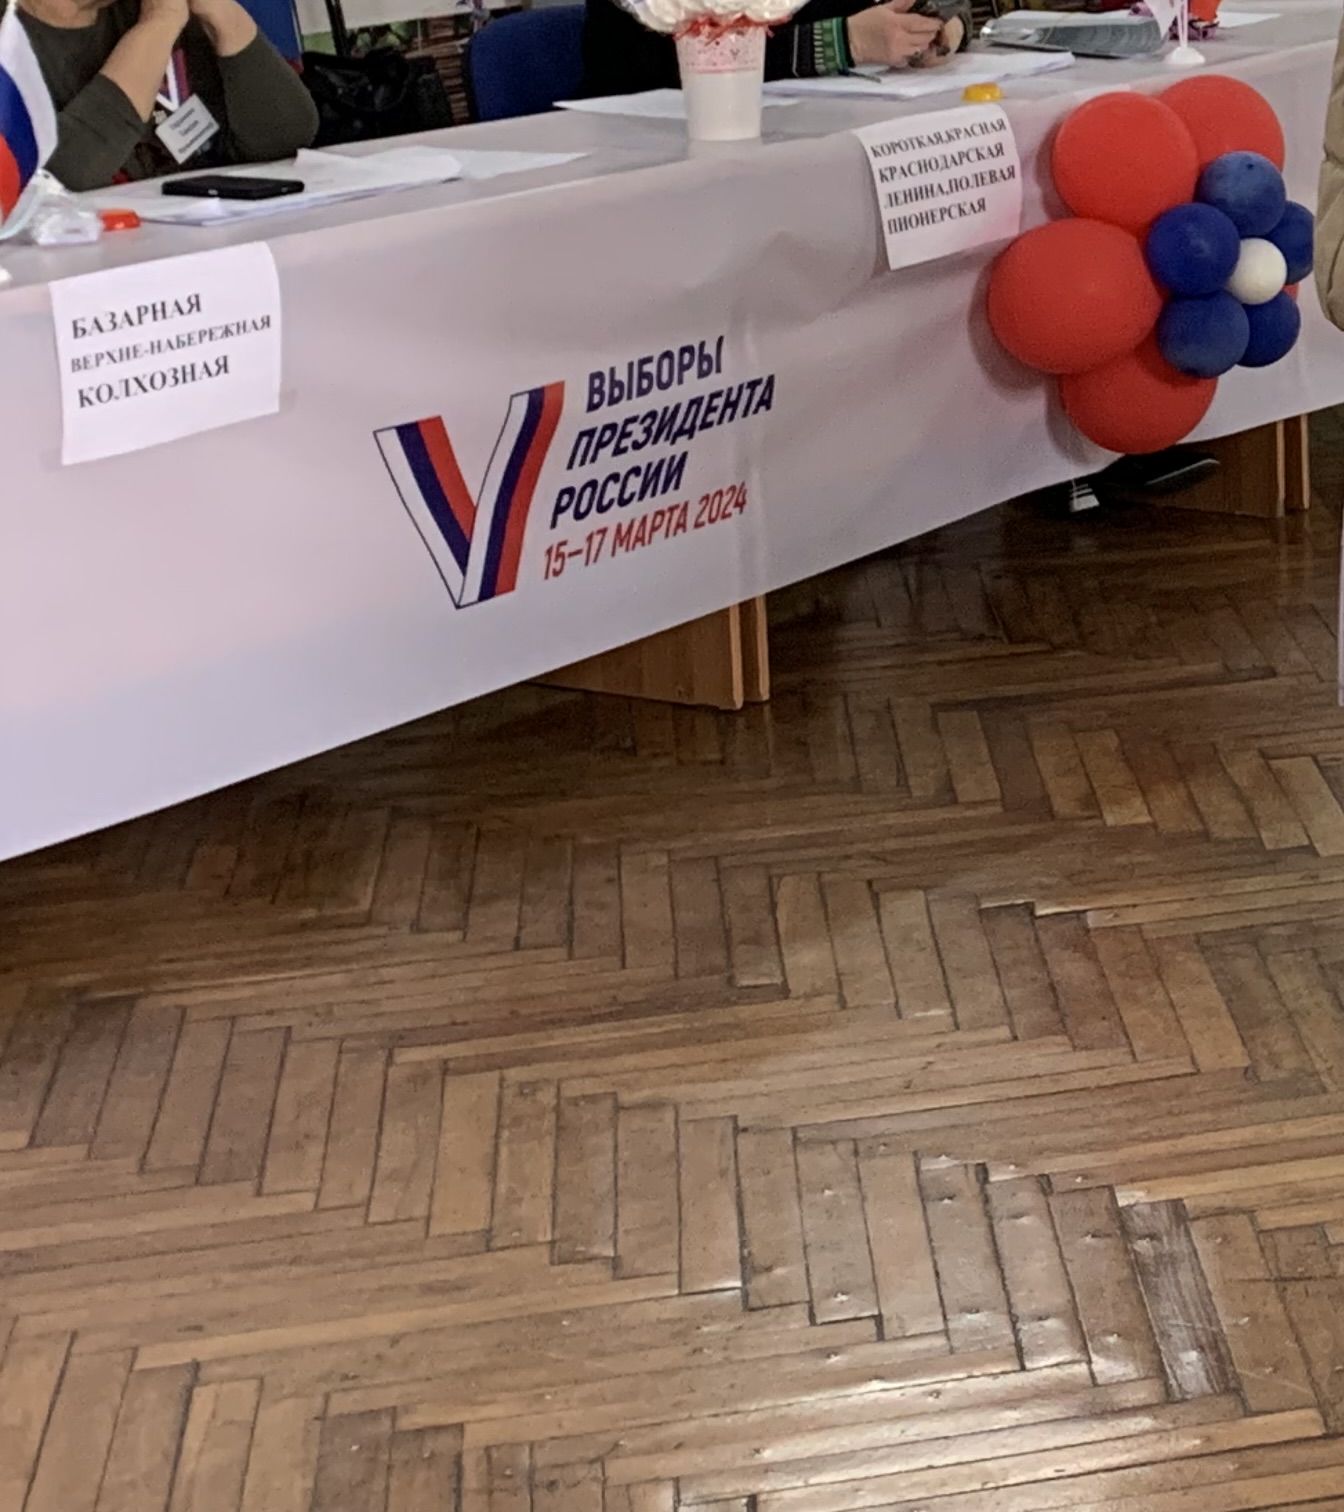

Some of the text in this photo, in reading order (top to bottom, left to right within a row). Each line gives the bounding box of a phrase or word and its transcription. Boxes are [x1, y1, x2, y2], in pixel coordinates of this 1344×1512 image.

[878, 141, 1005, 184] КРАСНОДАРСКАЯ
[887, 197, 987, 235] ПИОНЕРСКАЯ
[70, 315, 272, 373] ВЕРХНЕ-НАБЕРЕЖНАЯ
[71, 293, 203, 340] БАЗАРНАЯ
[77, 354, 230, 409] КОЛХОЗНАЯ
[586, 335, 725, 414] ВЫБОРЫ
[565, 374, 776, 471] ПРЕЗИДЕНТА
[549, 451, 689, 530] РОССИИ
[611, 505, 687, 558] МАРТА
[693, 481, 749, 530] 2024
